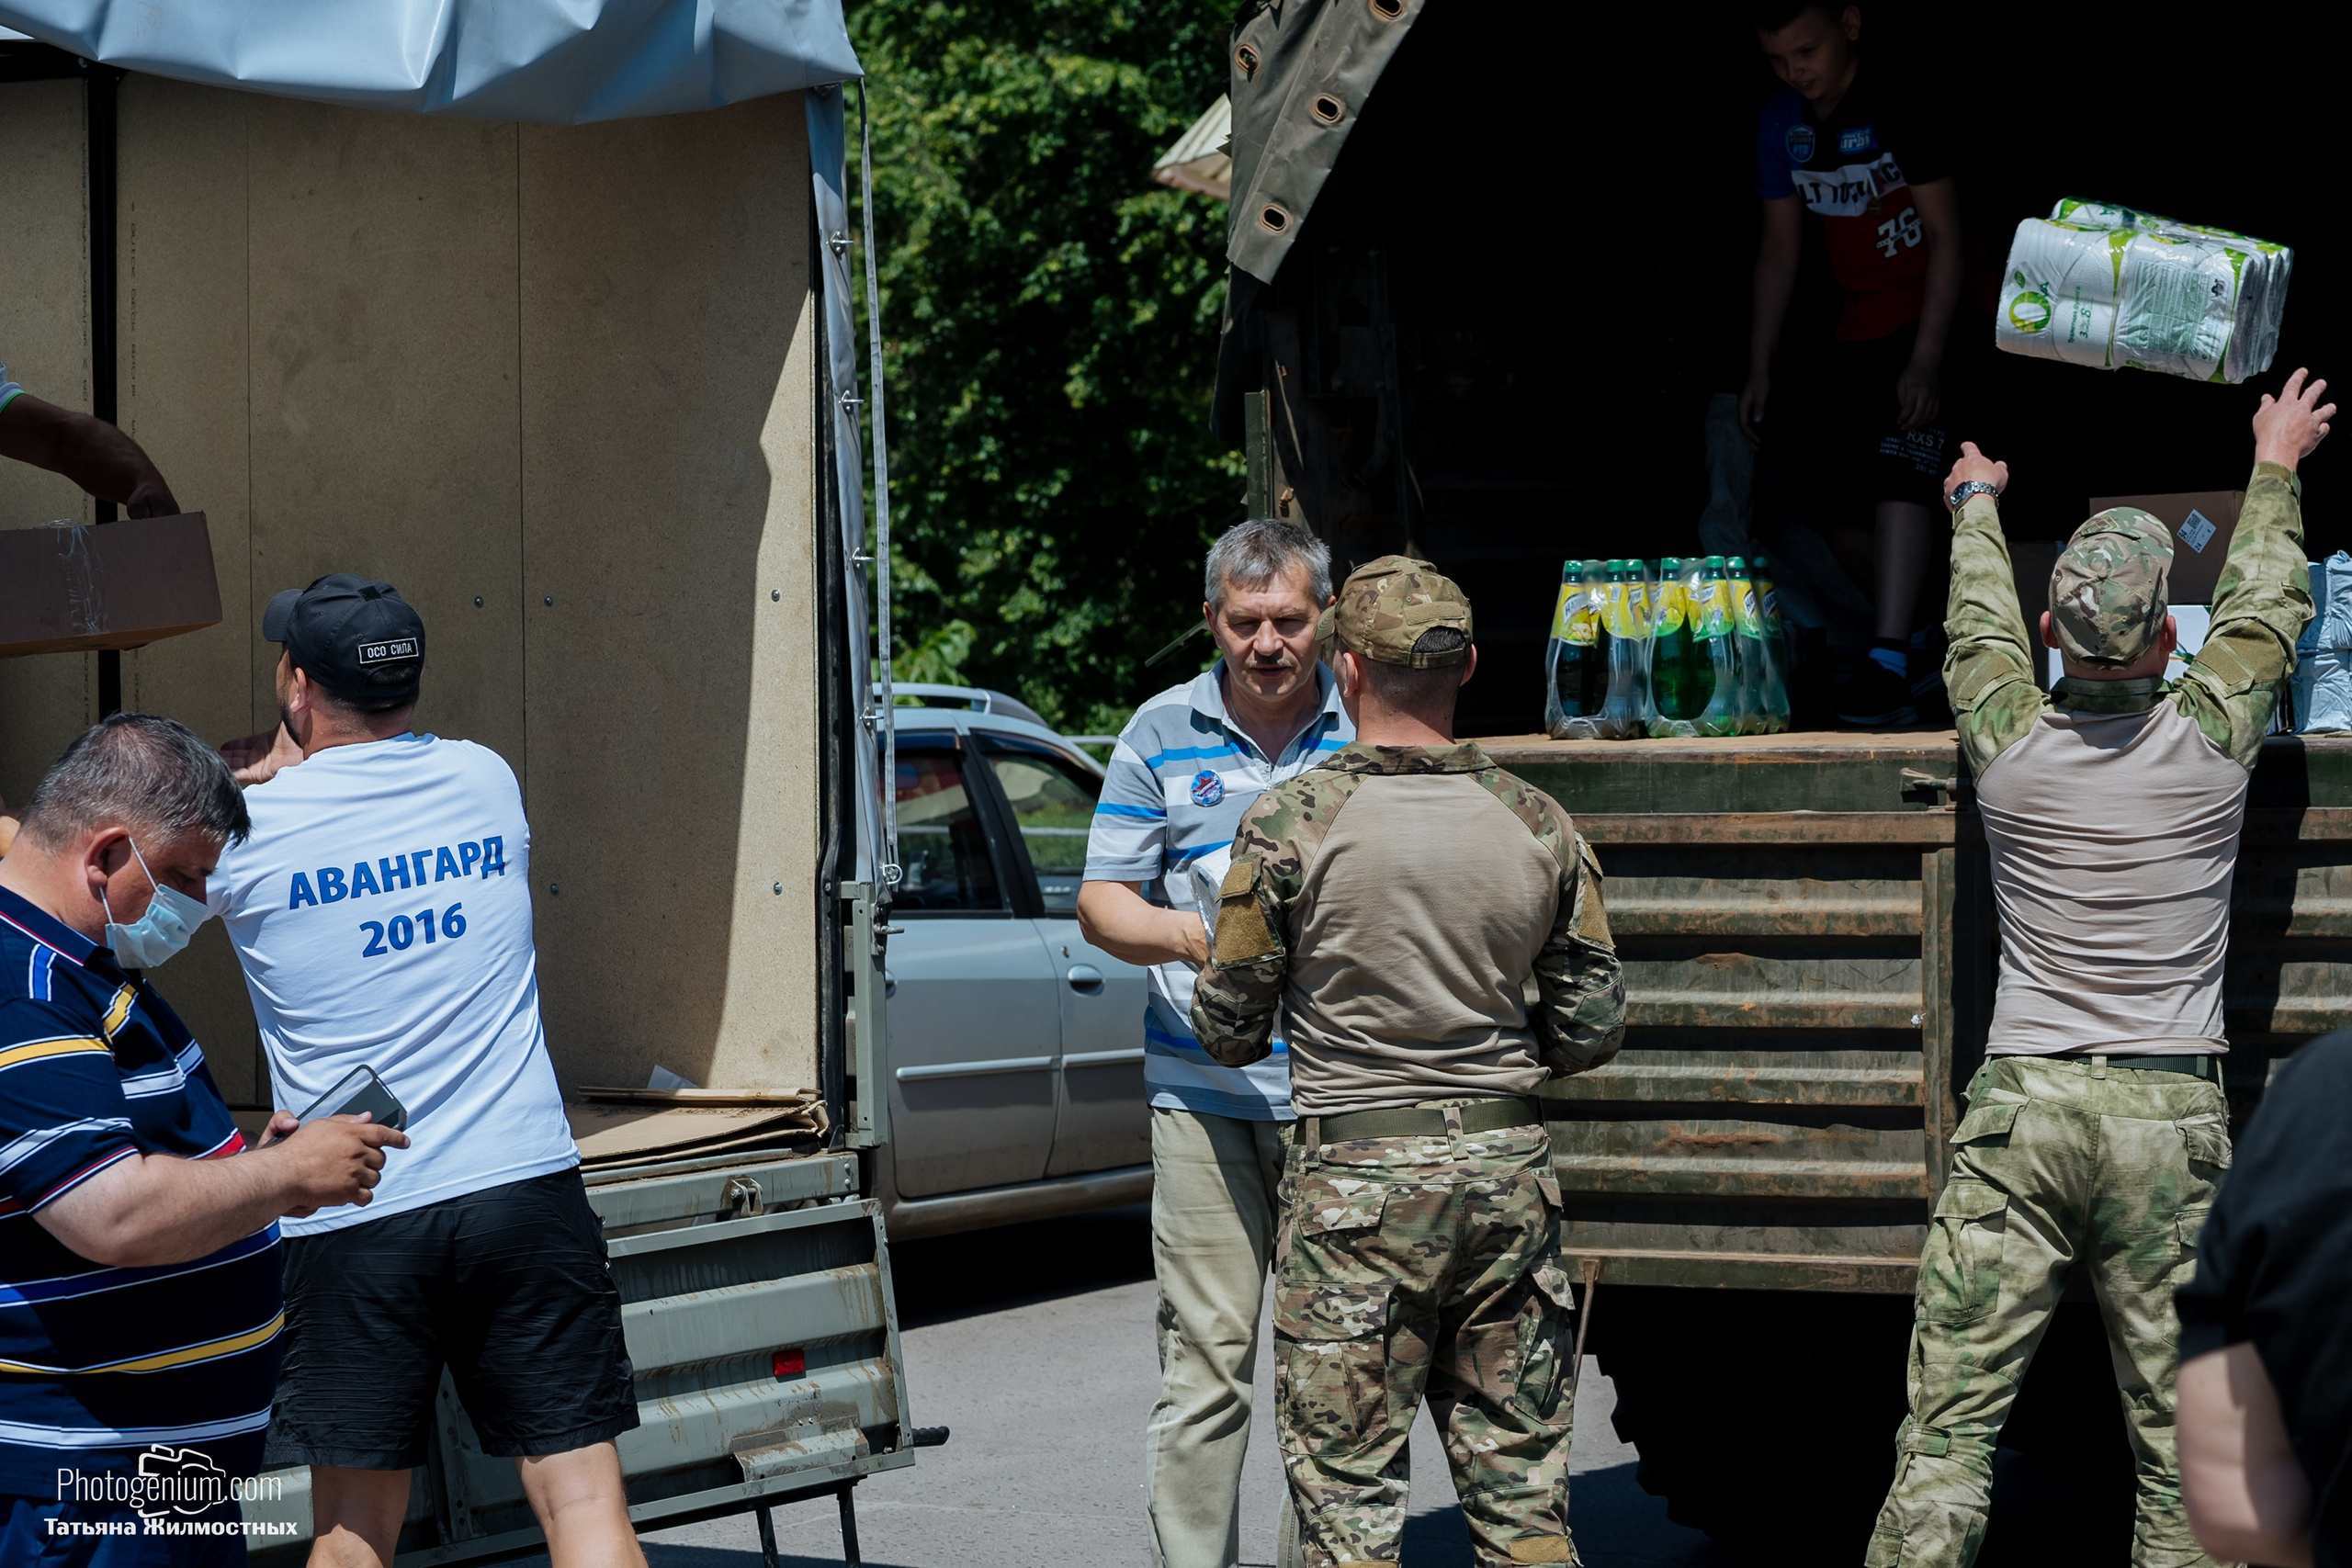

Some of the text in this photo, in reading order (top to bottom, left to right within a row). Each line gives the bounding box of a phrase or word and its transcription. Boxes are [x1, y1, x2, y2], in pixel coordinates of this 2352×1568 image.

[1906, 428, 1946, 450] RXS 7
[367, 641, 413, 659] ОСО СИЛА
[288, 834, 506, 910] АВАНГАРД
[359, 901, 468, 958] 2016
